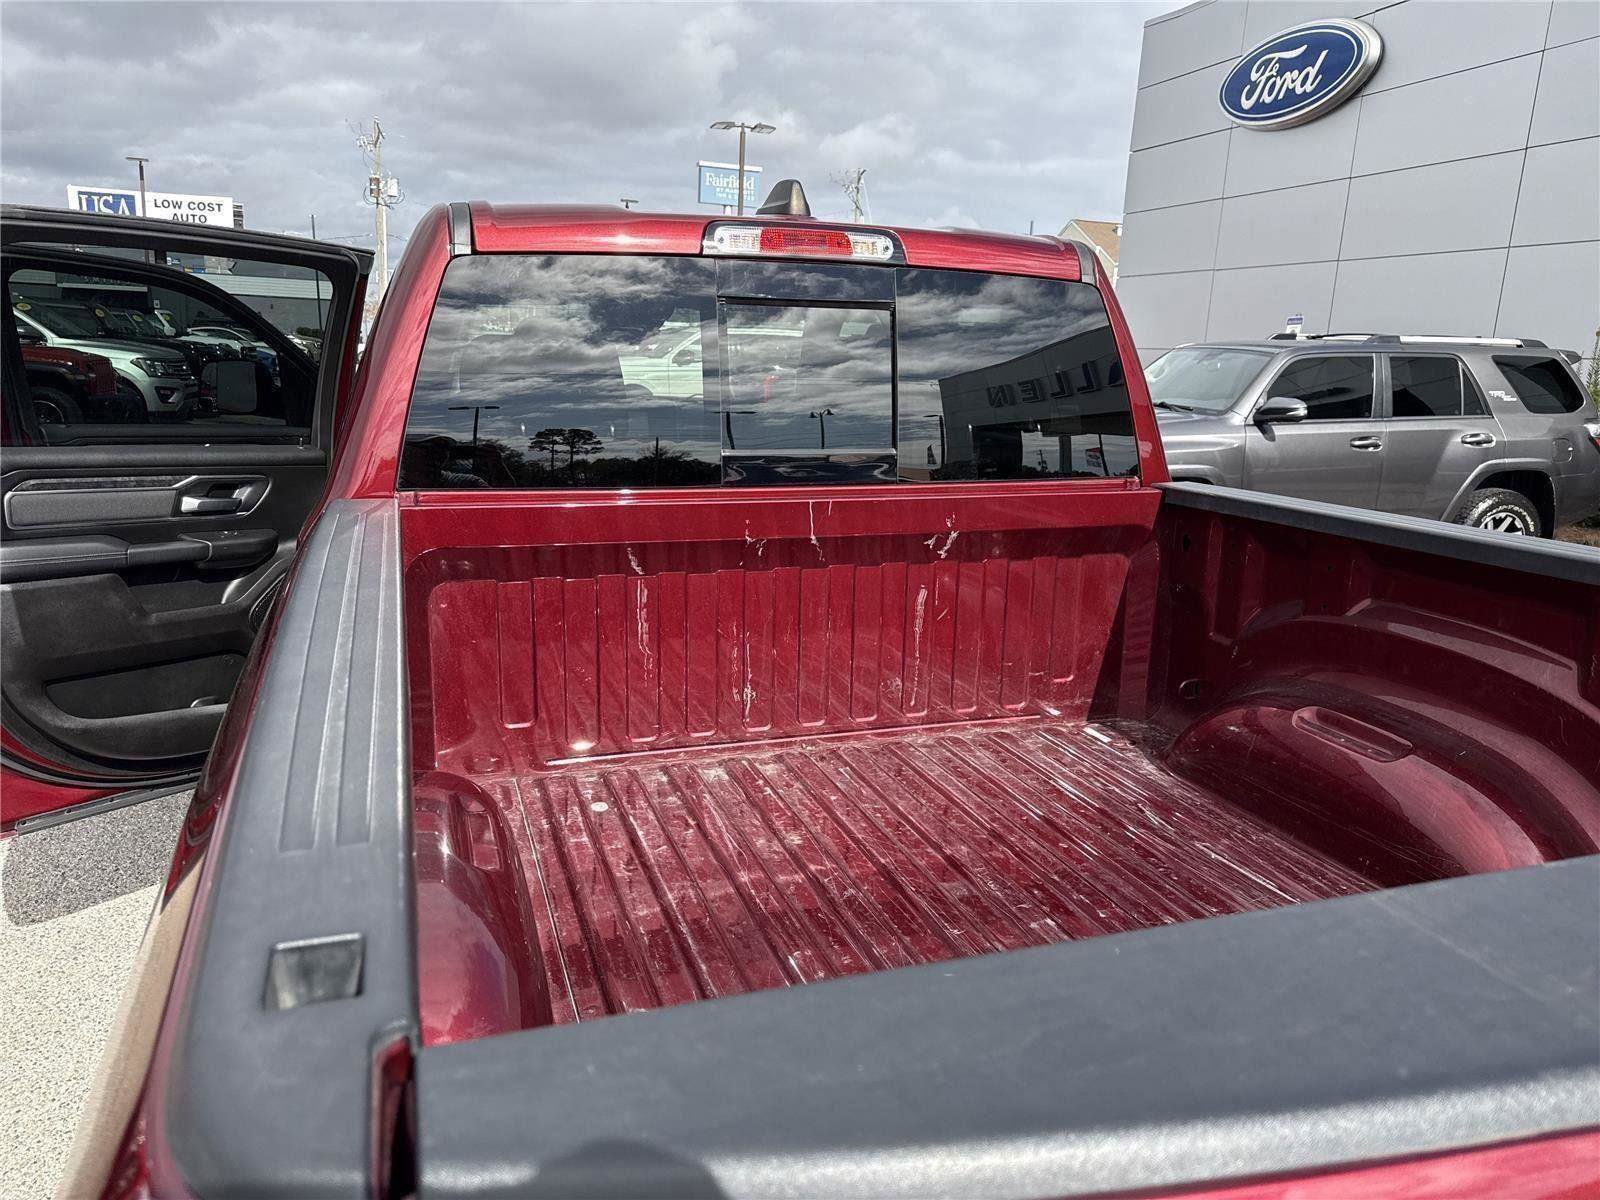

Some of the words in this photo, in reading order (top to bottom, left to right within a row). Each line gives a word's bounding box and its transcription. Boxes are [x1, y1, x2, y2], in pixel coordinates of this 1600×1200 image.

[1240, 44, 1329, 110] Ford
[79, 194, 132, 216] USA
[154, 198, 183, 210] LOW
[187, 201, 223, 213] COST
[172, 212, 208, 224] AUTO
